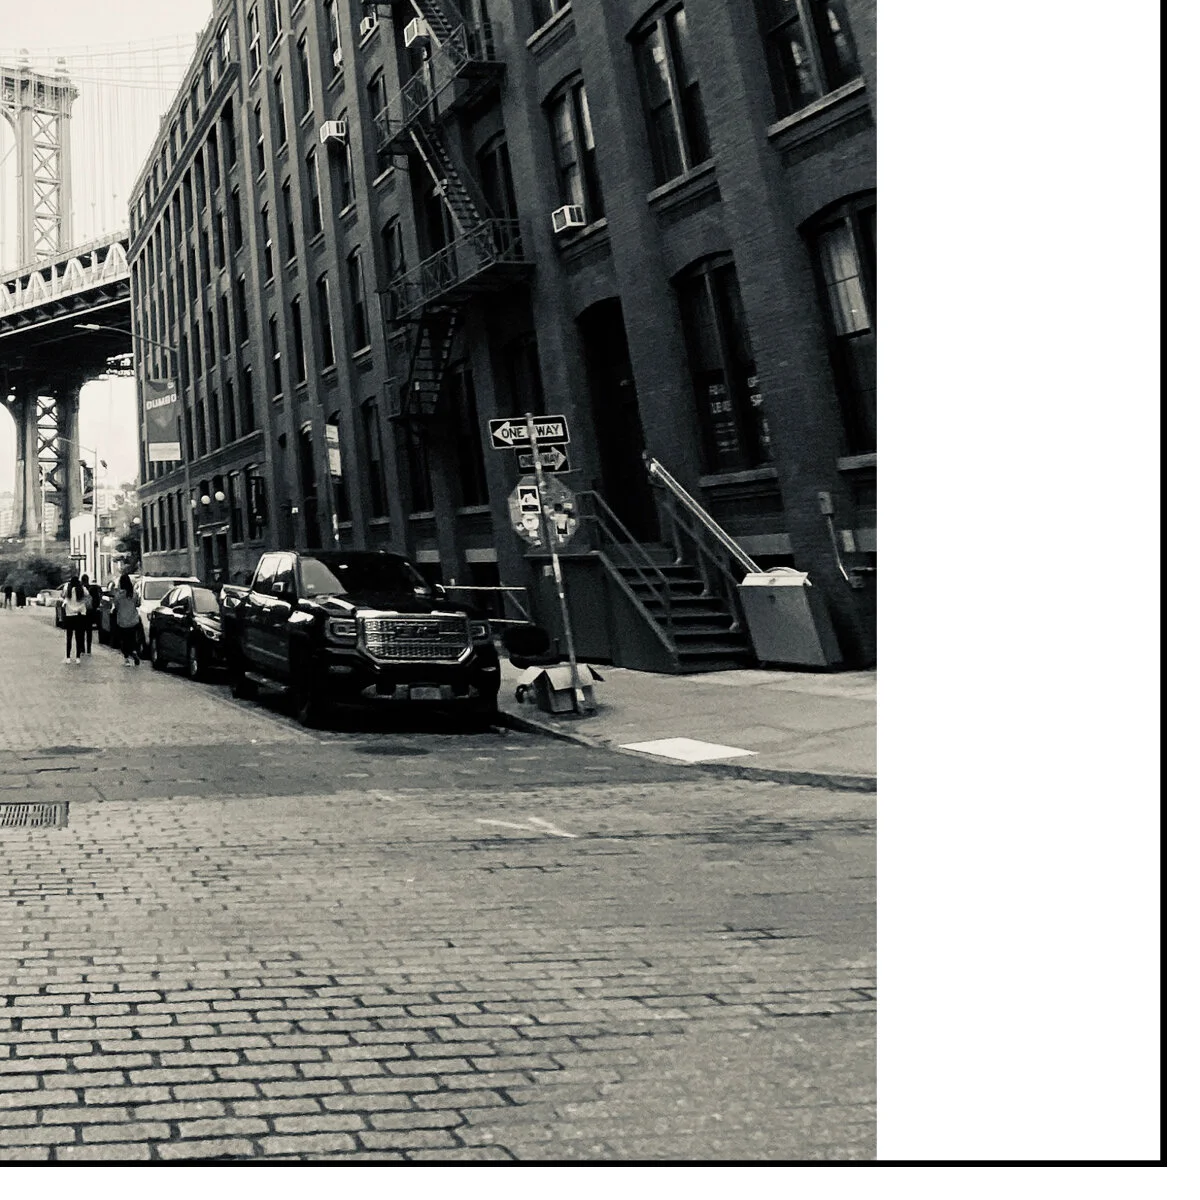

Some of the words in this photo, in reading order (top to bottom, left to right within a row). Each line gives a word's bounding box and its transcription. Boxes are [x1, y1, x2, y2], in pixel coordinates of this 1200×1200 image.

[146, 393, 177, 410] DUMBO
[501, 427, 525, 439] ONE
[535, 424, 560, 436] WAY
